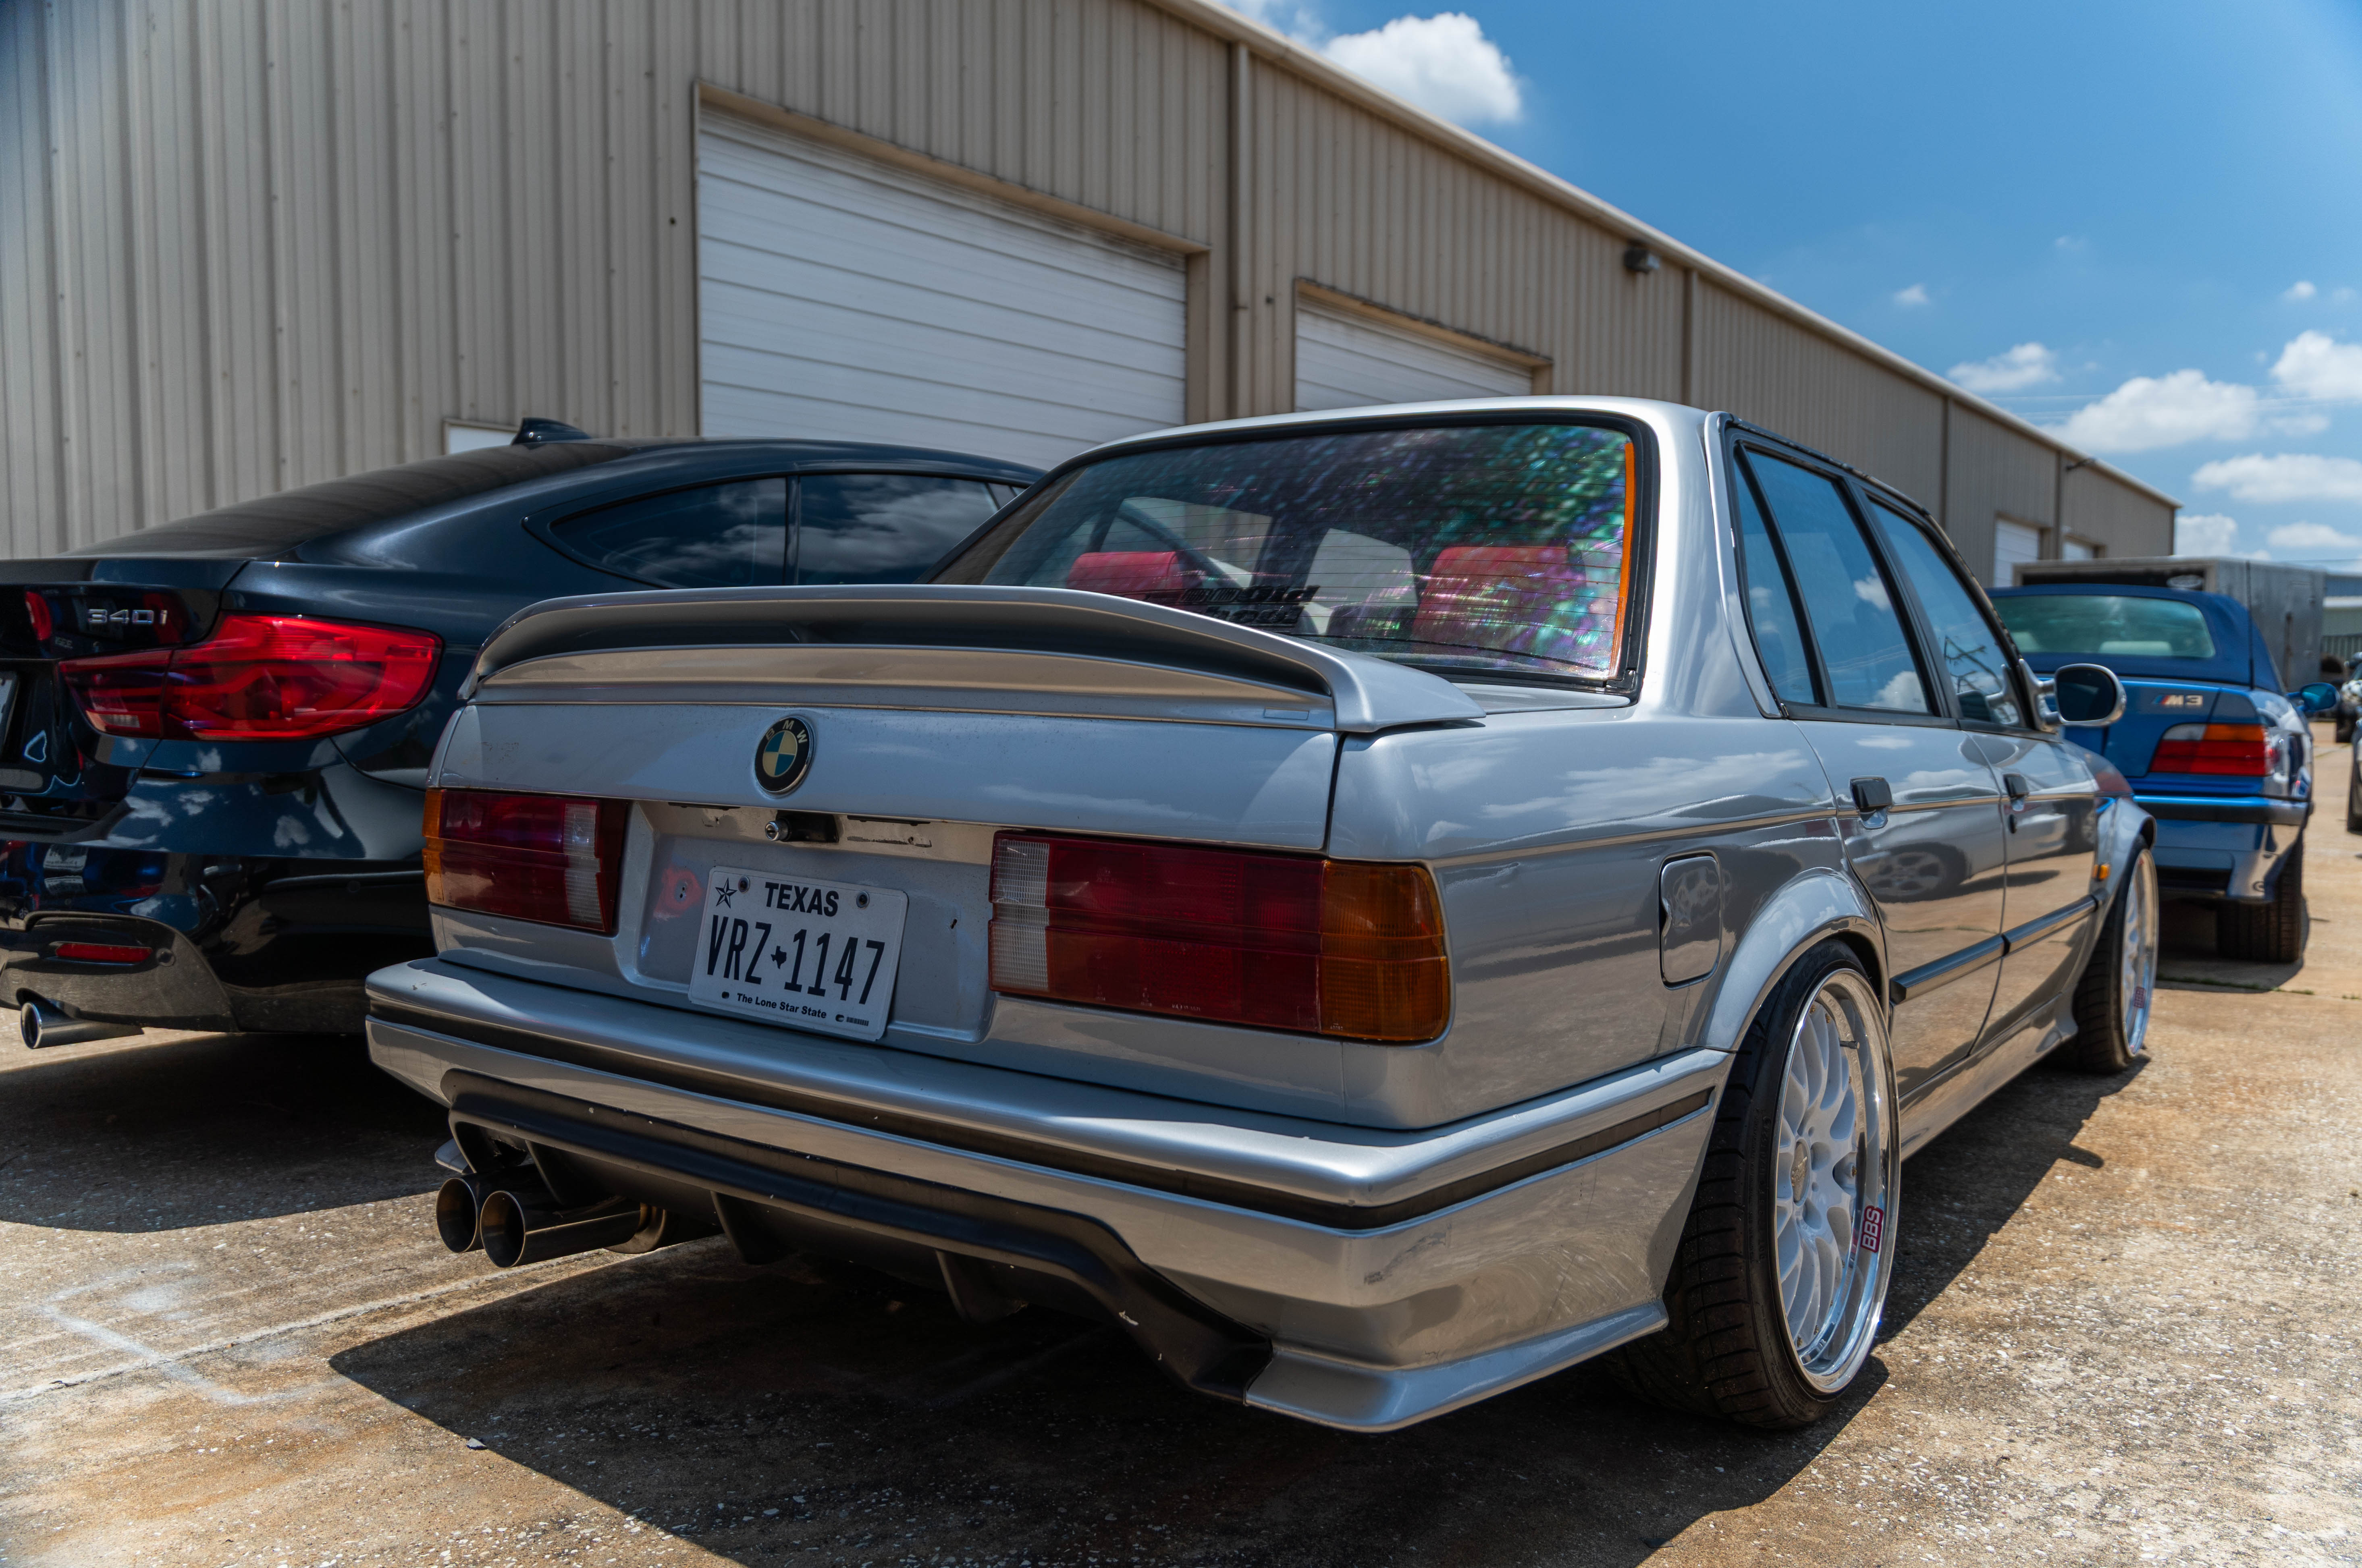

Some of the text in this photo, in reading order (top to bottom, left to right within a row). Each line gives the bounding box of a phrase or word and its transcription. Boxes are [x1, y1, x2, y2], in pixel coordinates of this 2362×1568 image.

[88, 609, 168, 625] 340i
[2159, 695, 2204, 706] M3
[765, 720, 808, 744] BMW
[764, 881, 839, 917] TEXAS
[707, 915, 885, 1005] VRZ 1147
[737, 993, 827, 1018] The Lone Star State
[1862, 1208, 1880, 1250] BBS
